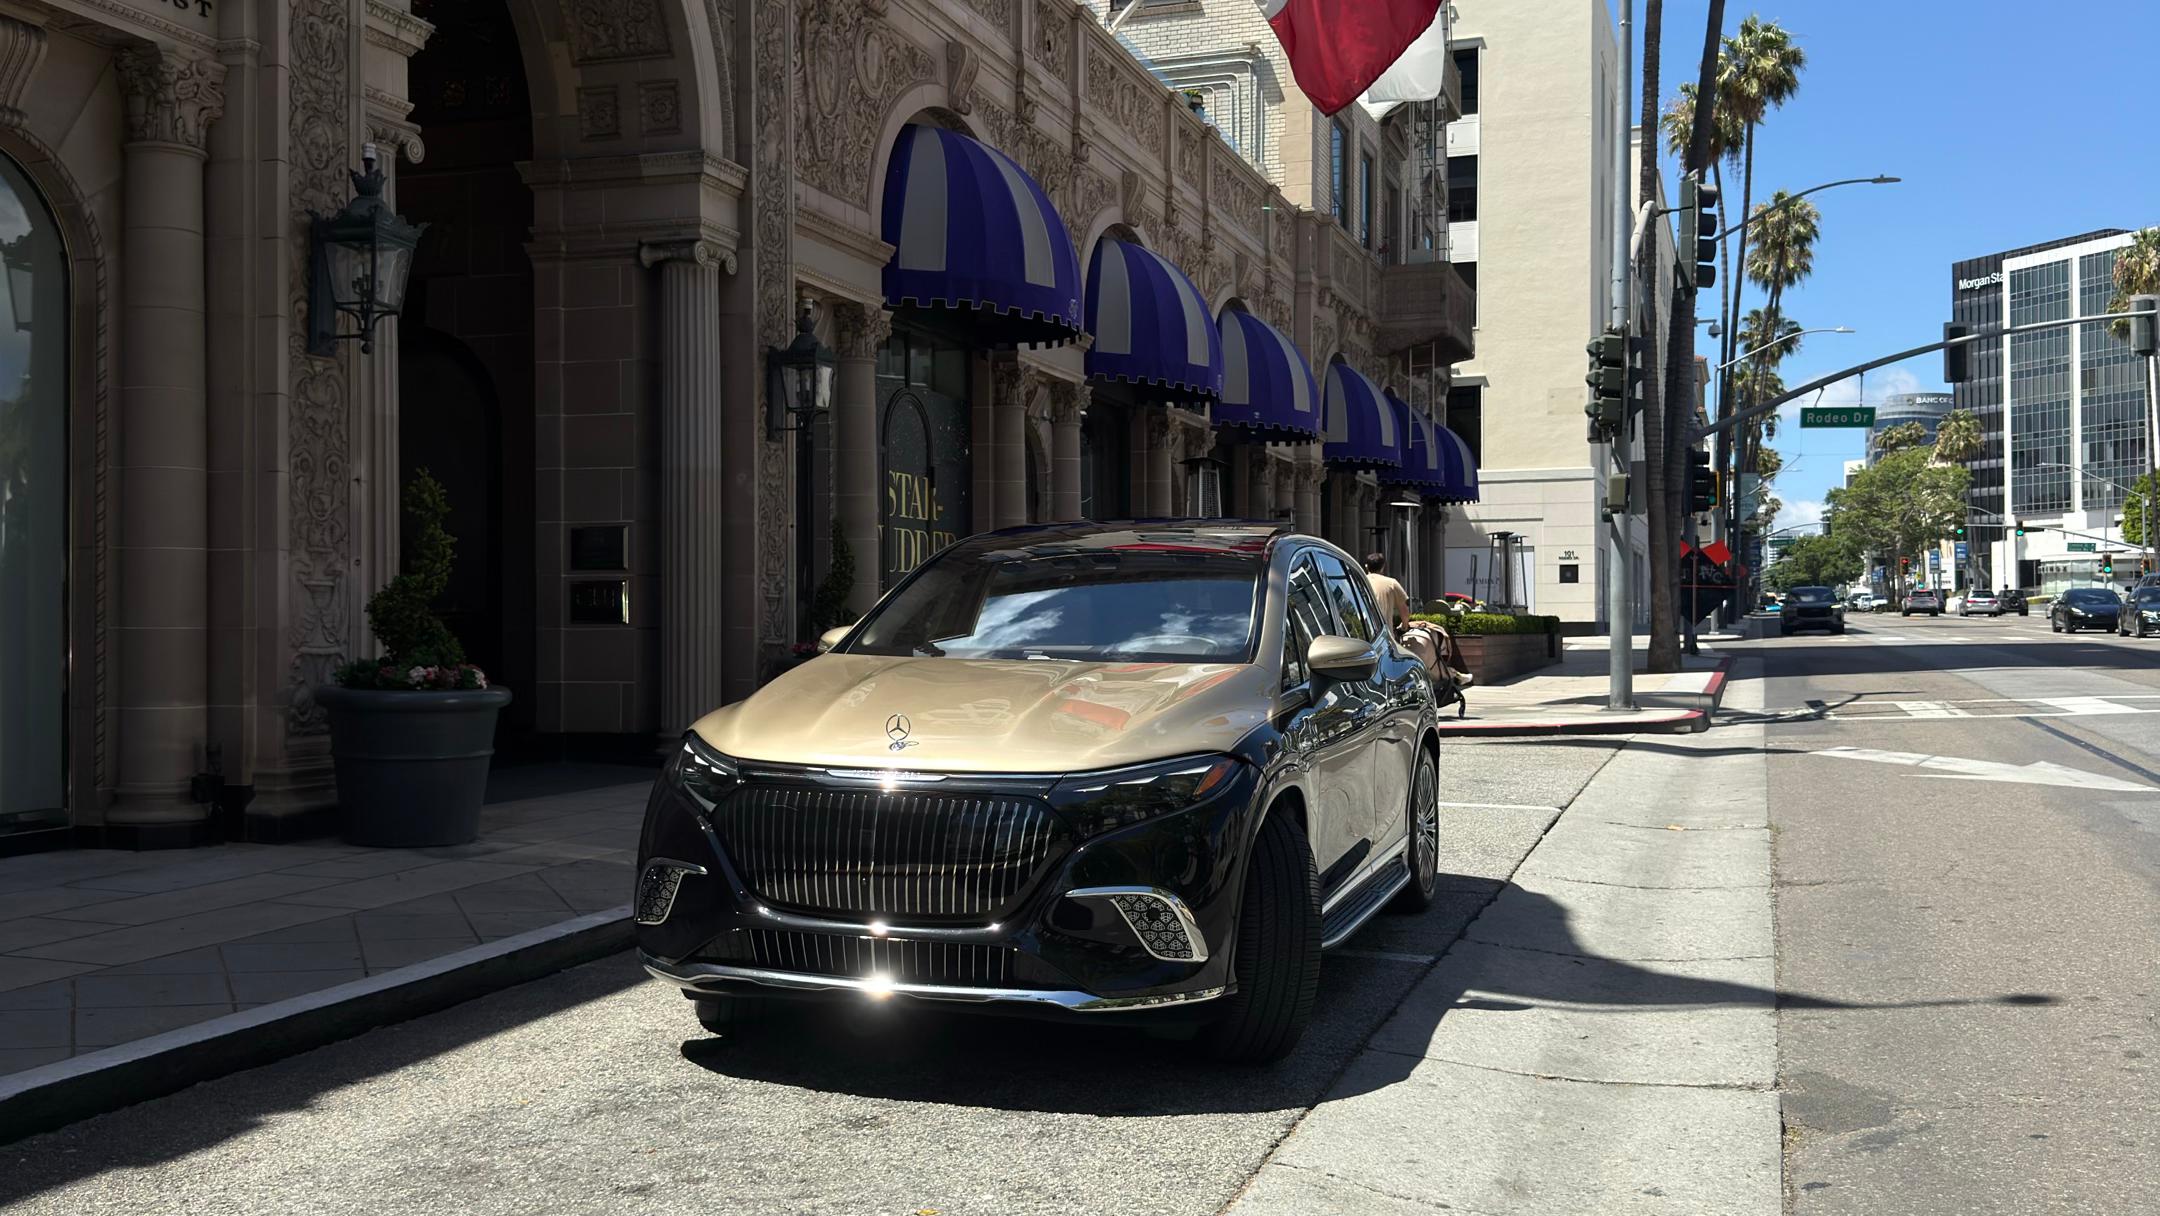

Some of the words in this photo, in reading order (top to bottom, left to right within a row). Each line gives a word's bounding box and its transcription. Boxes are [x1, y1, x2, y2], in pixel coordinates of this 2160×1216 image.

[1958, 276, 1990, 290] Morgan
[1806, 412, 1848, 423] Rodeo
[1853, 412, 1869, 423] Dr
